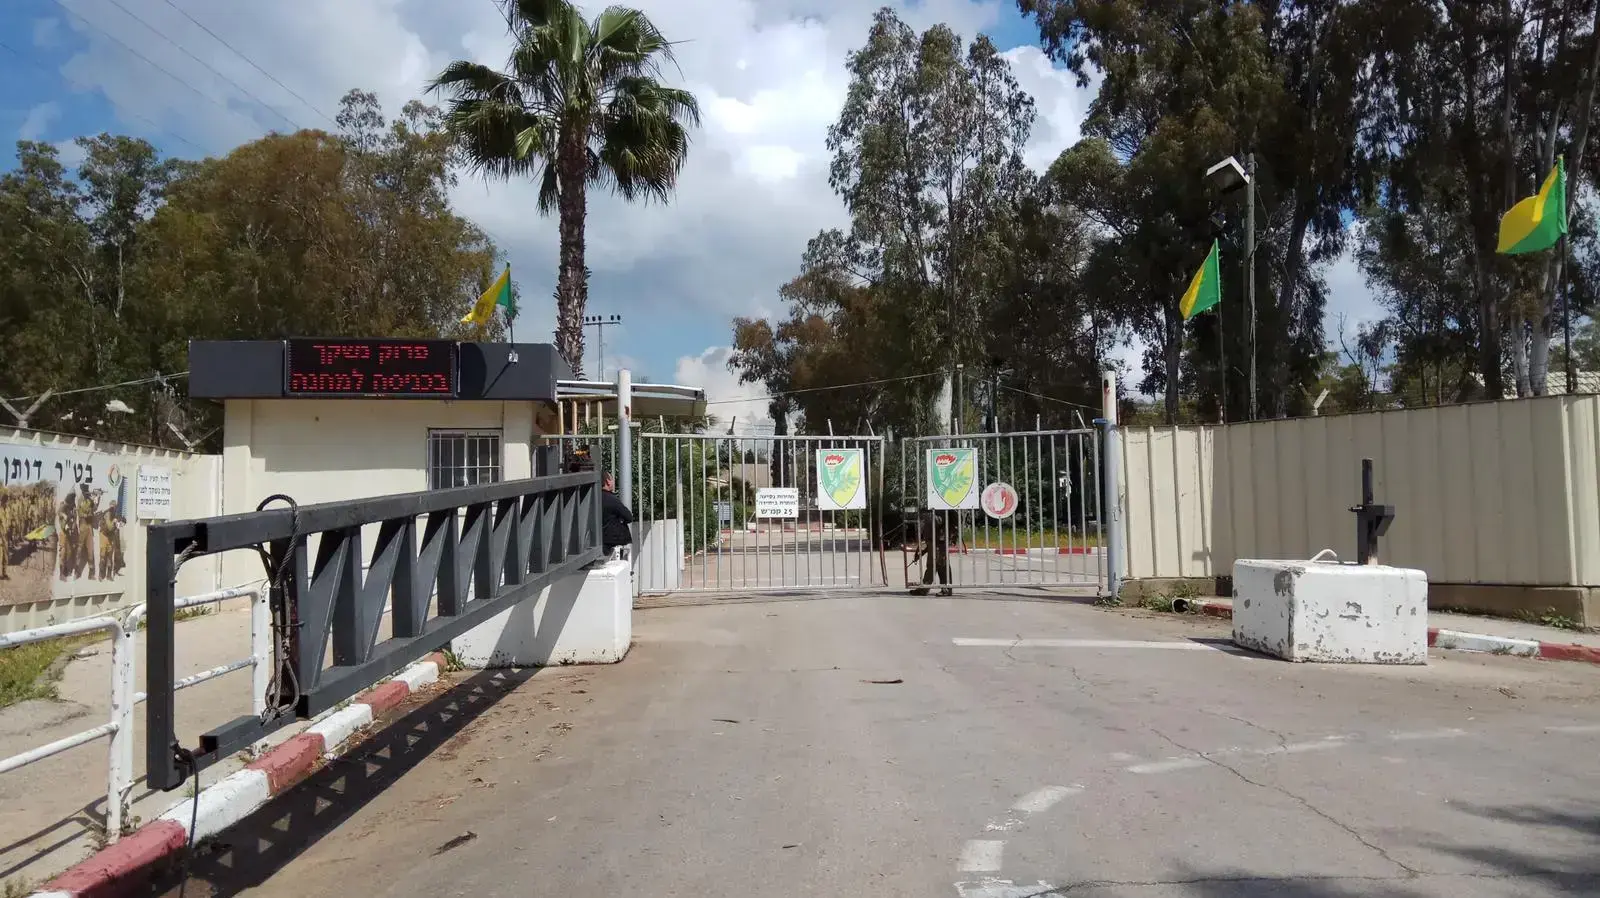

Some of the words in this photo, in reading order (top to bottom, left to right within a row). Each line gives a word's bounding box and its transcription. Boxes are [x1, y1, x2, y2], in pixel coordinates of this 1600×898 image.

[312, 345, 371, 365] נשקך
[379, 346, 429, 365] פרוק
[292, 368, 364, 390] למחנה
[373, 374, 449, 390] בכניסה
[3, 456, 43, 486] דותן
[54, 459, 93, 484] בט"ר
[784, 508, 793, 516] 25
